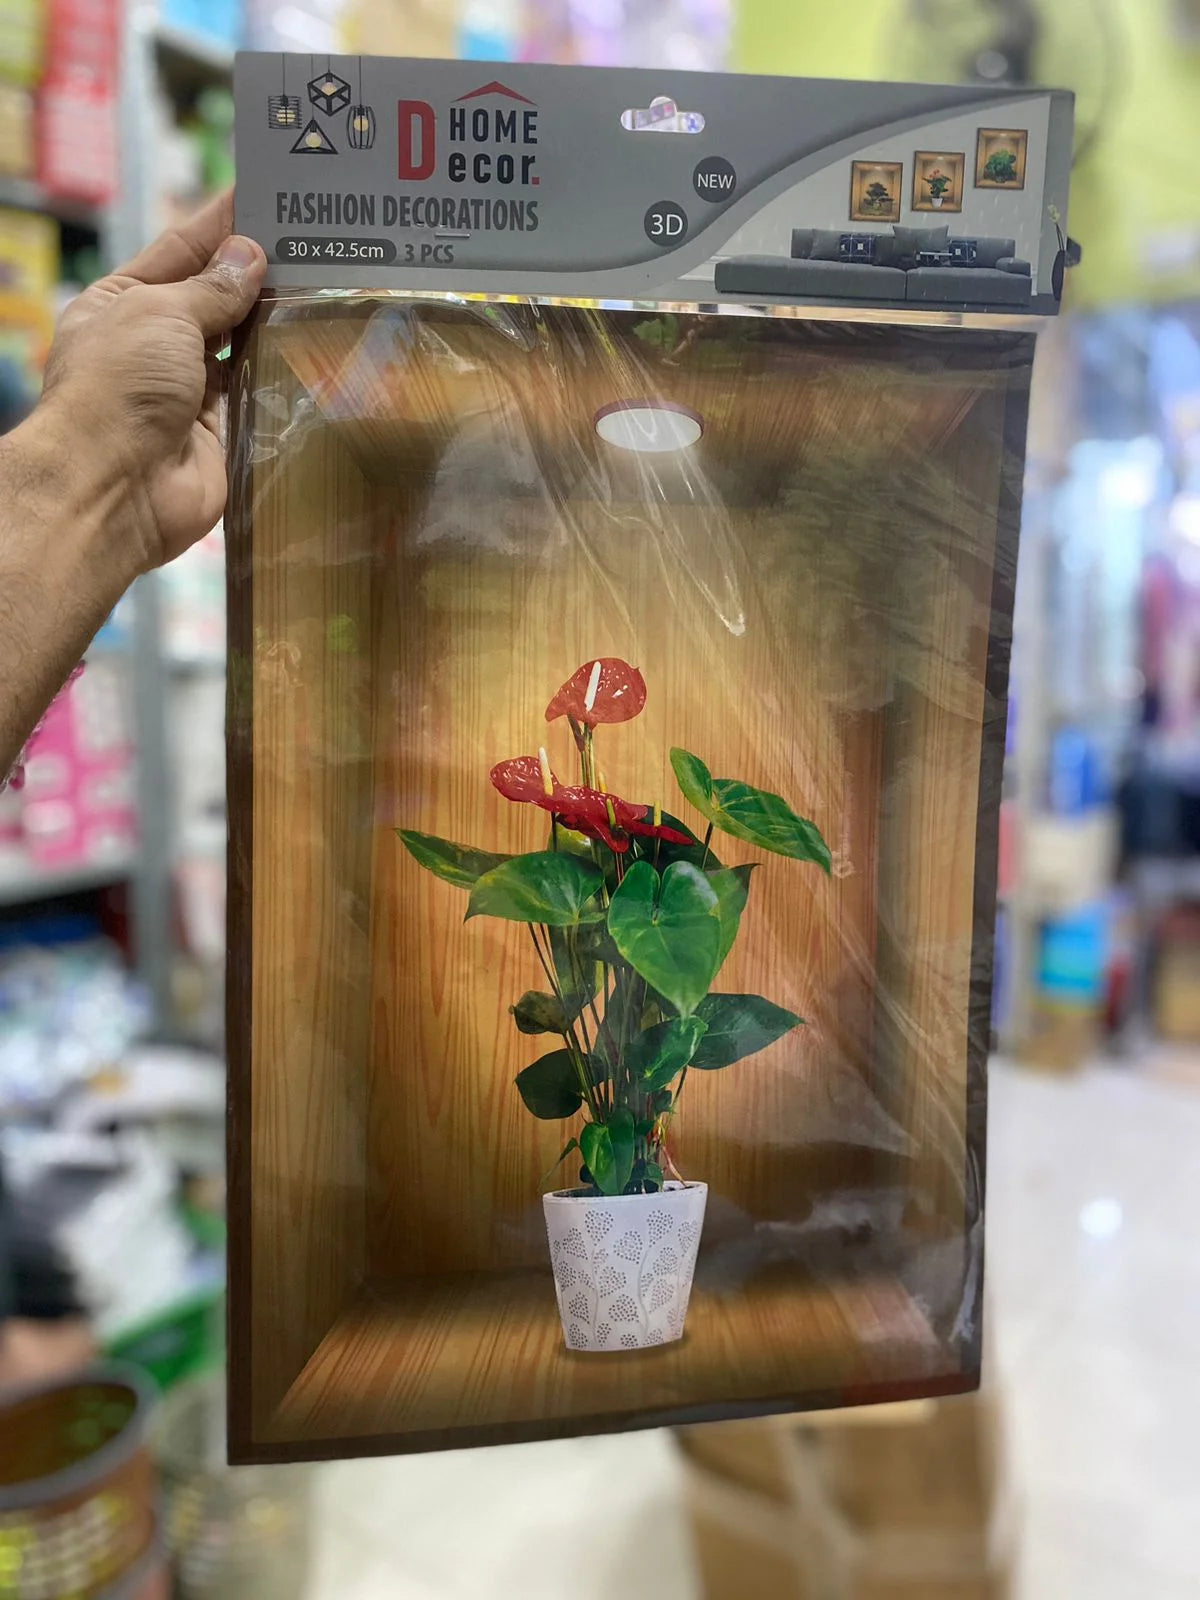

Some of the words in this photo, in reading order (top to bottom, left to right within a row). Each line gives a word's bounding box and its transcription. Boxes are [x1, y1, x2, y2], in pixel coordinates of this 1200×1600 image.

[450, 108, 538, 144] HOME
[697, 173, 734, 189] NEW
[275, 192, 376, 226] FASHION
[382, 195, 539, 231] DECORATIONS
[650, 213, 684, 235] 3D
[287, 241, 308, 257] 30
[311, 246, 321, 257] x
[324, 242, 384, 259] 42.5cm
[404, 244, 415, 262] 3
[420, 244, 454, 264] PCS
